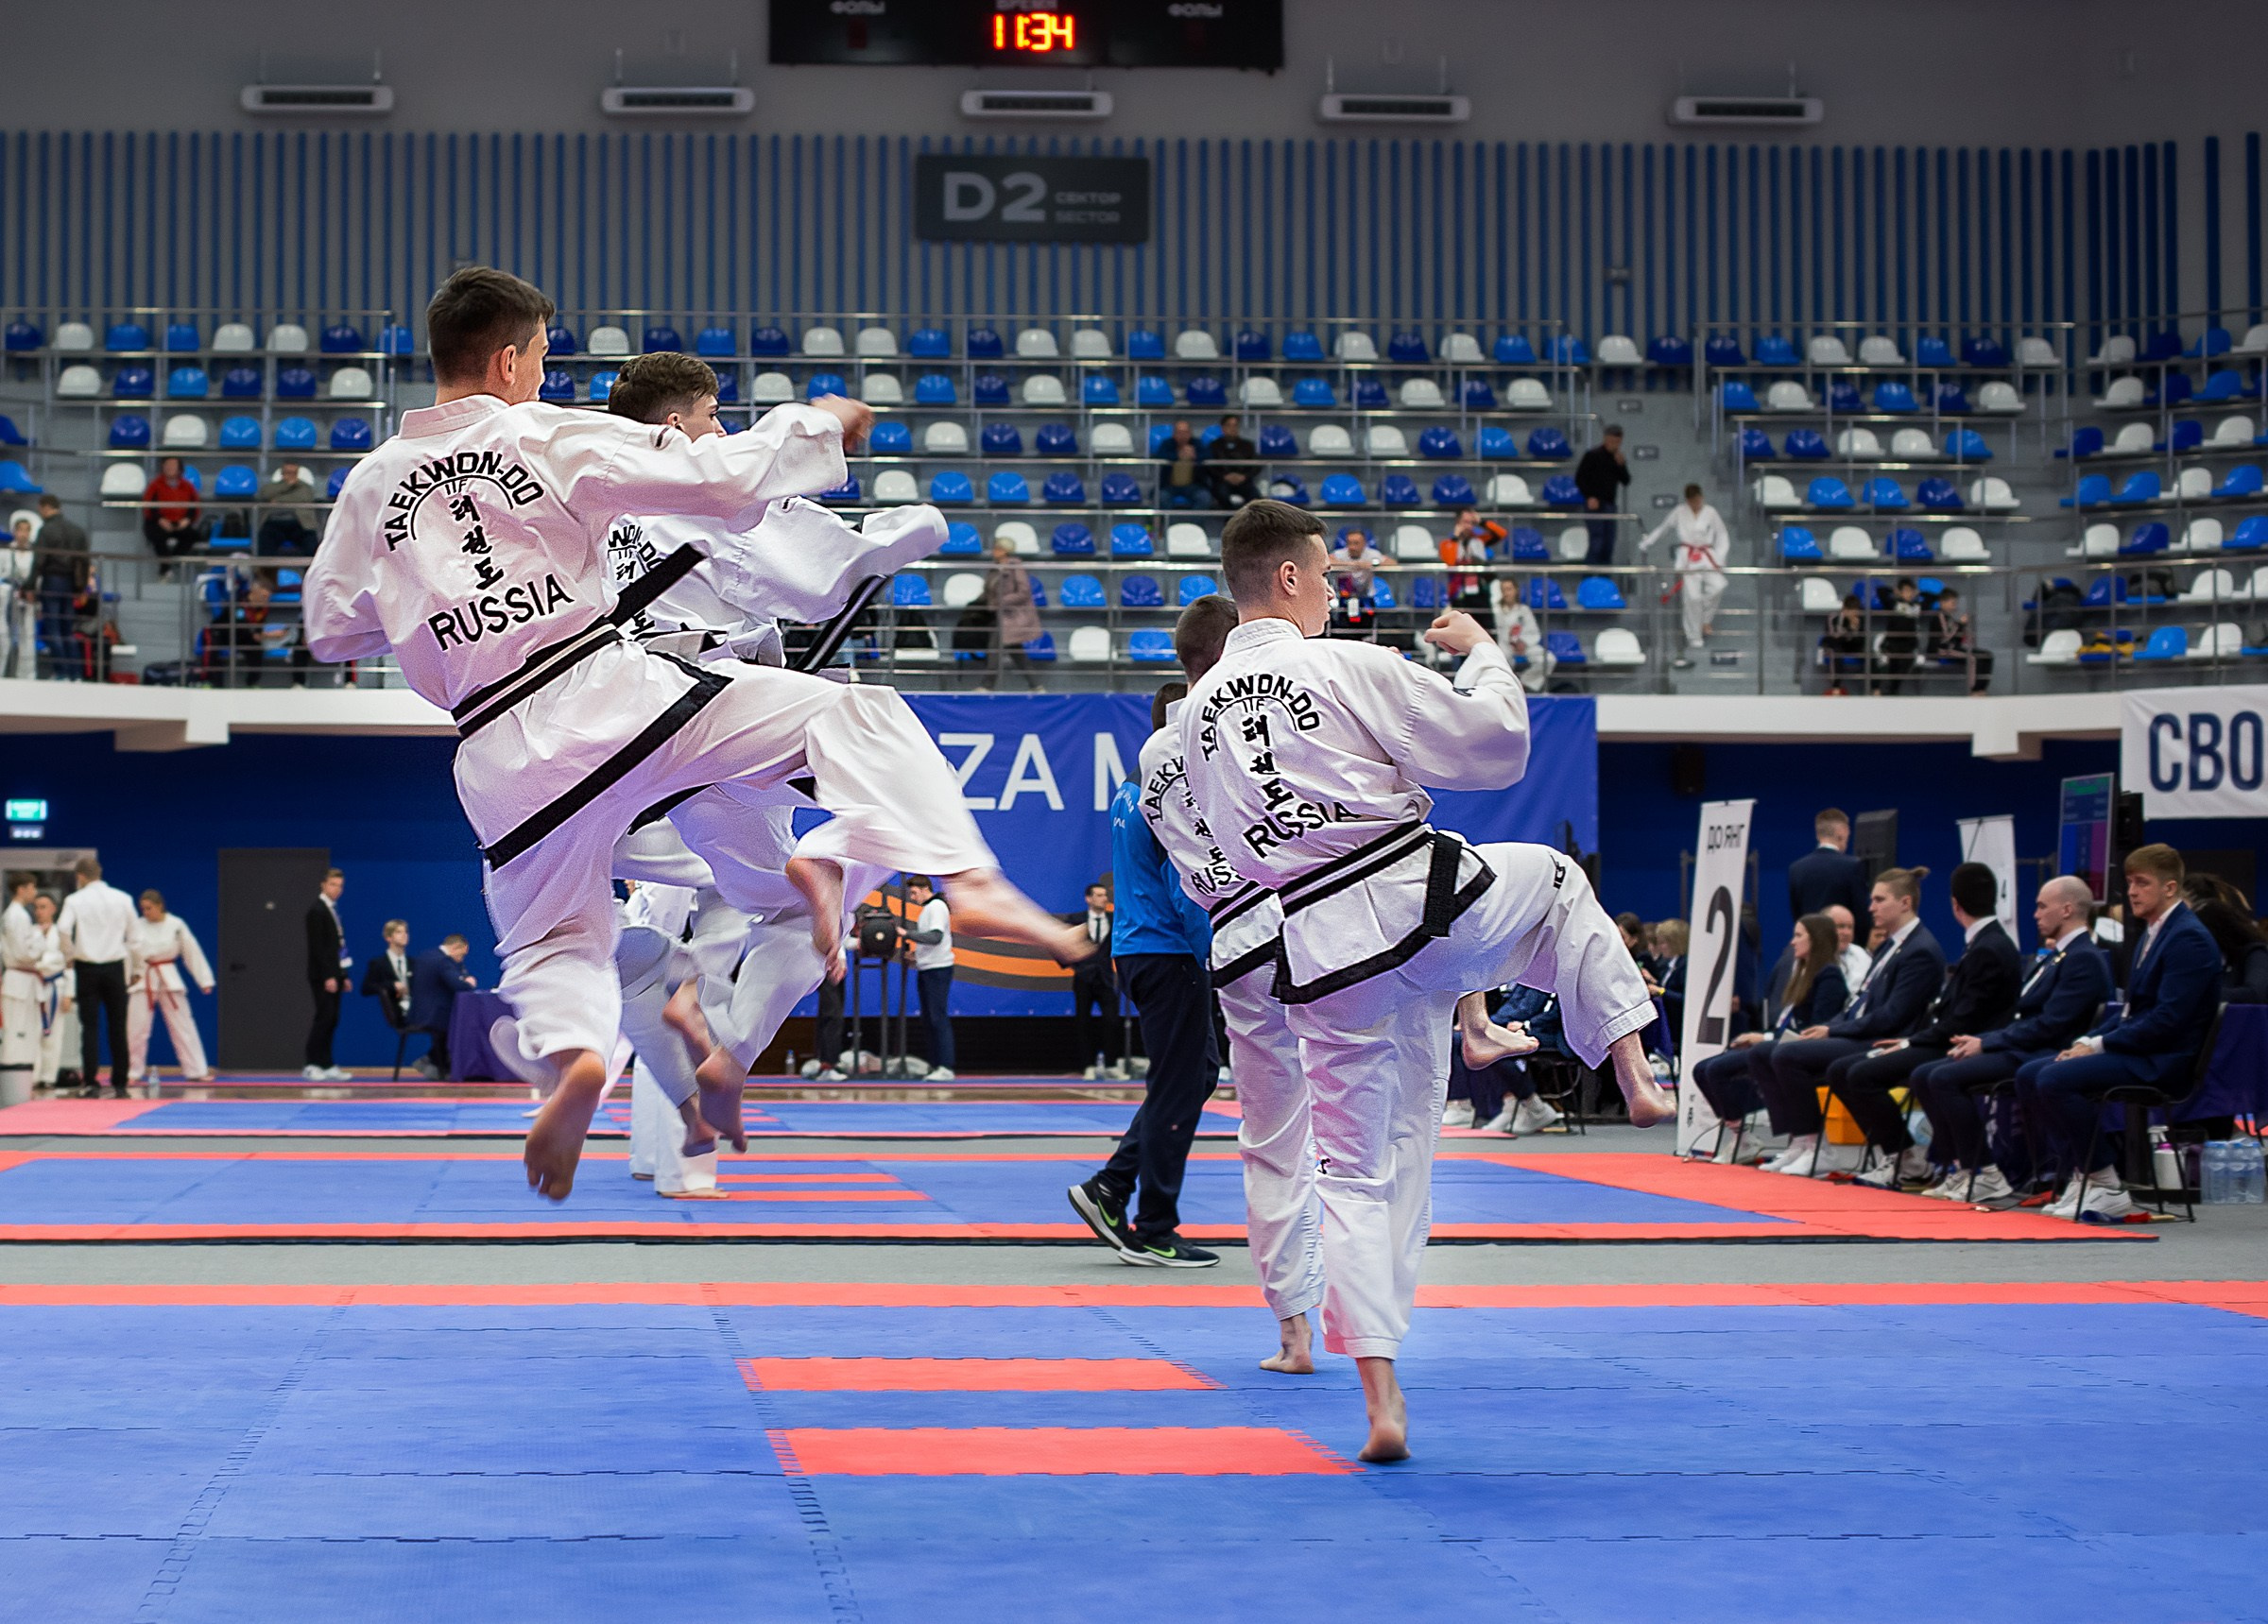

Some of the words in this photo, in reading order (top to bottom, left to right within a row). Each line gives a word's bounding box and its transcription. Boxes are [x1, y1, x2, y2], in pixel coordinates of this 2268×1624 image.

[943, 171, 1047, 222] D2
[385, 451, 544, 551] TAEKWON-DO
[428, 573, 575, 651] RUSSIA
[1201, 674, 1320, 761] TAEKWON-DO
[1243, 801, 1361, 859] RUSSIA
[1696, 885, 1734, 1044] 2
